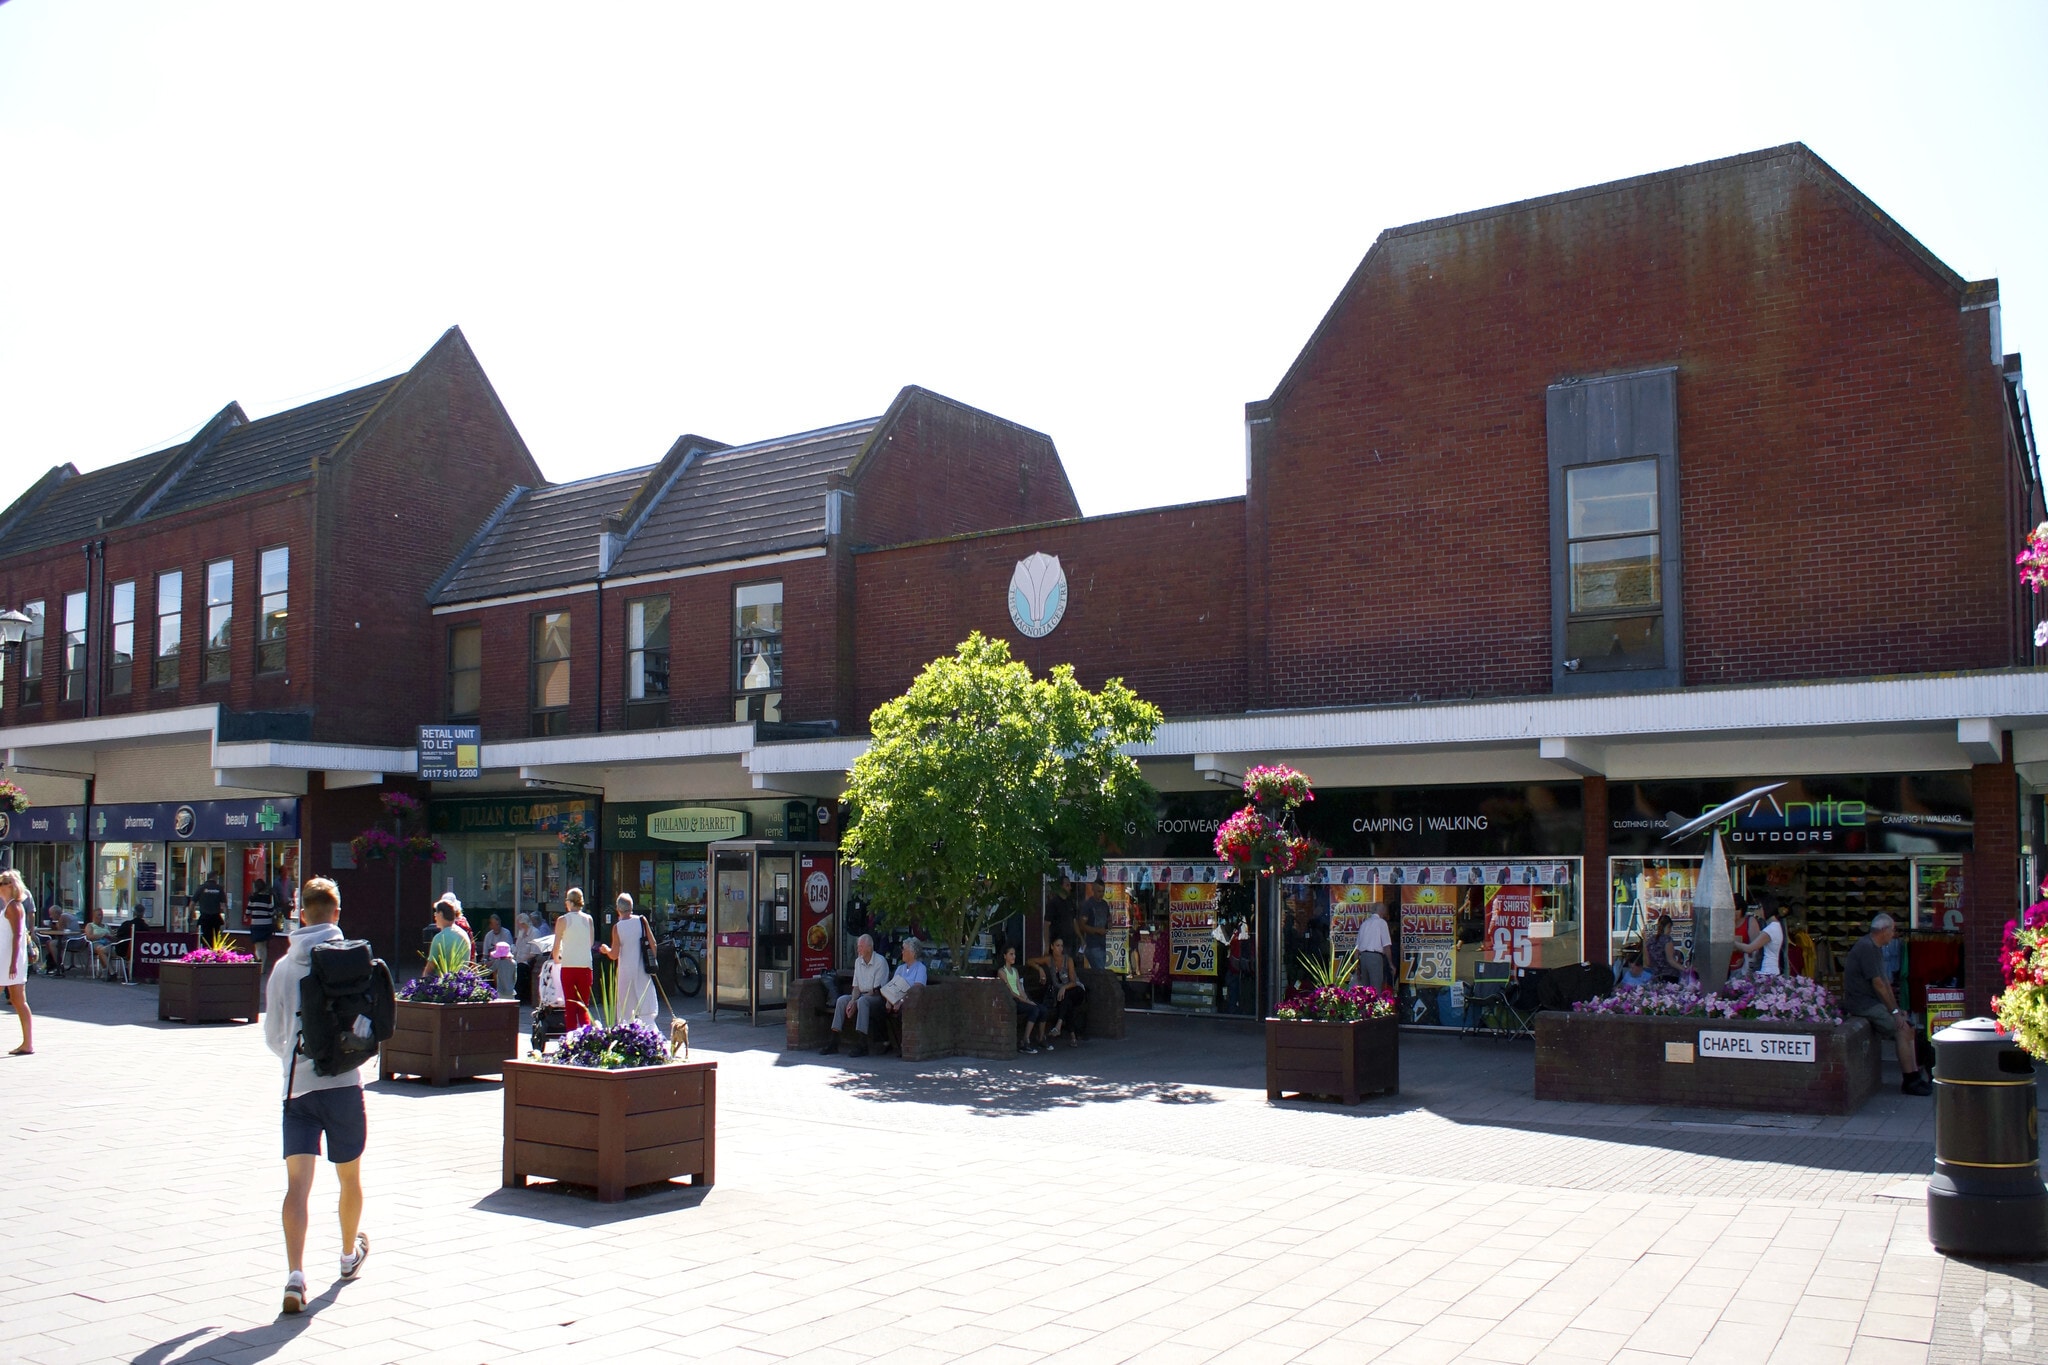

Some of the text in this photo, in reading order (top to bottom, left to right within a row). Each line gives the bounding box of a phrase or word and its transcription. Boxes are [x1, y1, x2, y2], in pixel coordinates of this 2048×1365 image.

[1013, 612, 1052, 636] MAGNOLIA
[422, 729, 475, 738] RETAIL UNIT
[422, 740, 453, 749] TO LET
[423, 769, 477, 778] 0117 910 2200
[125, 816, 154, 829] pharmacy
[225, 813, 249, 827] beauty
[460, 804, 558, 831] JULIAN GRAVES
[618, 814, 637, 825] health
[1882, 814, 1961, 824] CAMPING WALKING
[32, 818, 49, 831] beauty
[654, 816, 736, 833] HOLLAND & BARRETT
[1157, 820, 1219, 833] FOOTWEAR
[1352, 816, 1488, 832] CAMPING WALKING
[1613, 820, 1648, 828] CLOTHING
[618, 829, 636, 839] foods
[765, 828, 784, 837] reme
[1732, 831, 1833, 842] OUTDOORS
[810, 885, 829, 902] £1.49
[1170, 901, 1215, 911] SUMMER
[1402, 904, 1455, 915] SUMMER
[1498, 901, 1529, 912] T SHIRTS
[1171, 911, 1214, 928] SALE
[1403, 916, 1453, 933] SALE
[1495, 916, 1509, 927] ANY
[1511, 916, 1516, 927] 3
[141, 942, 187, 957] COSTA
[1492, 928, 1533, 968] £5
[1113, 957, 1125, 967] off
[1173, 944, 1214, 971] 75%
[1201, 959, 1213, 969] off
[1404, 951, 1452, 979] 75%
[1437, 968, 1451, 979] off
[1703, 1037, 1811, 1056] CHAPEL STREET
